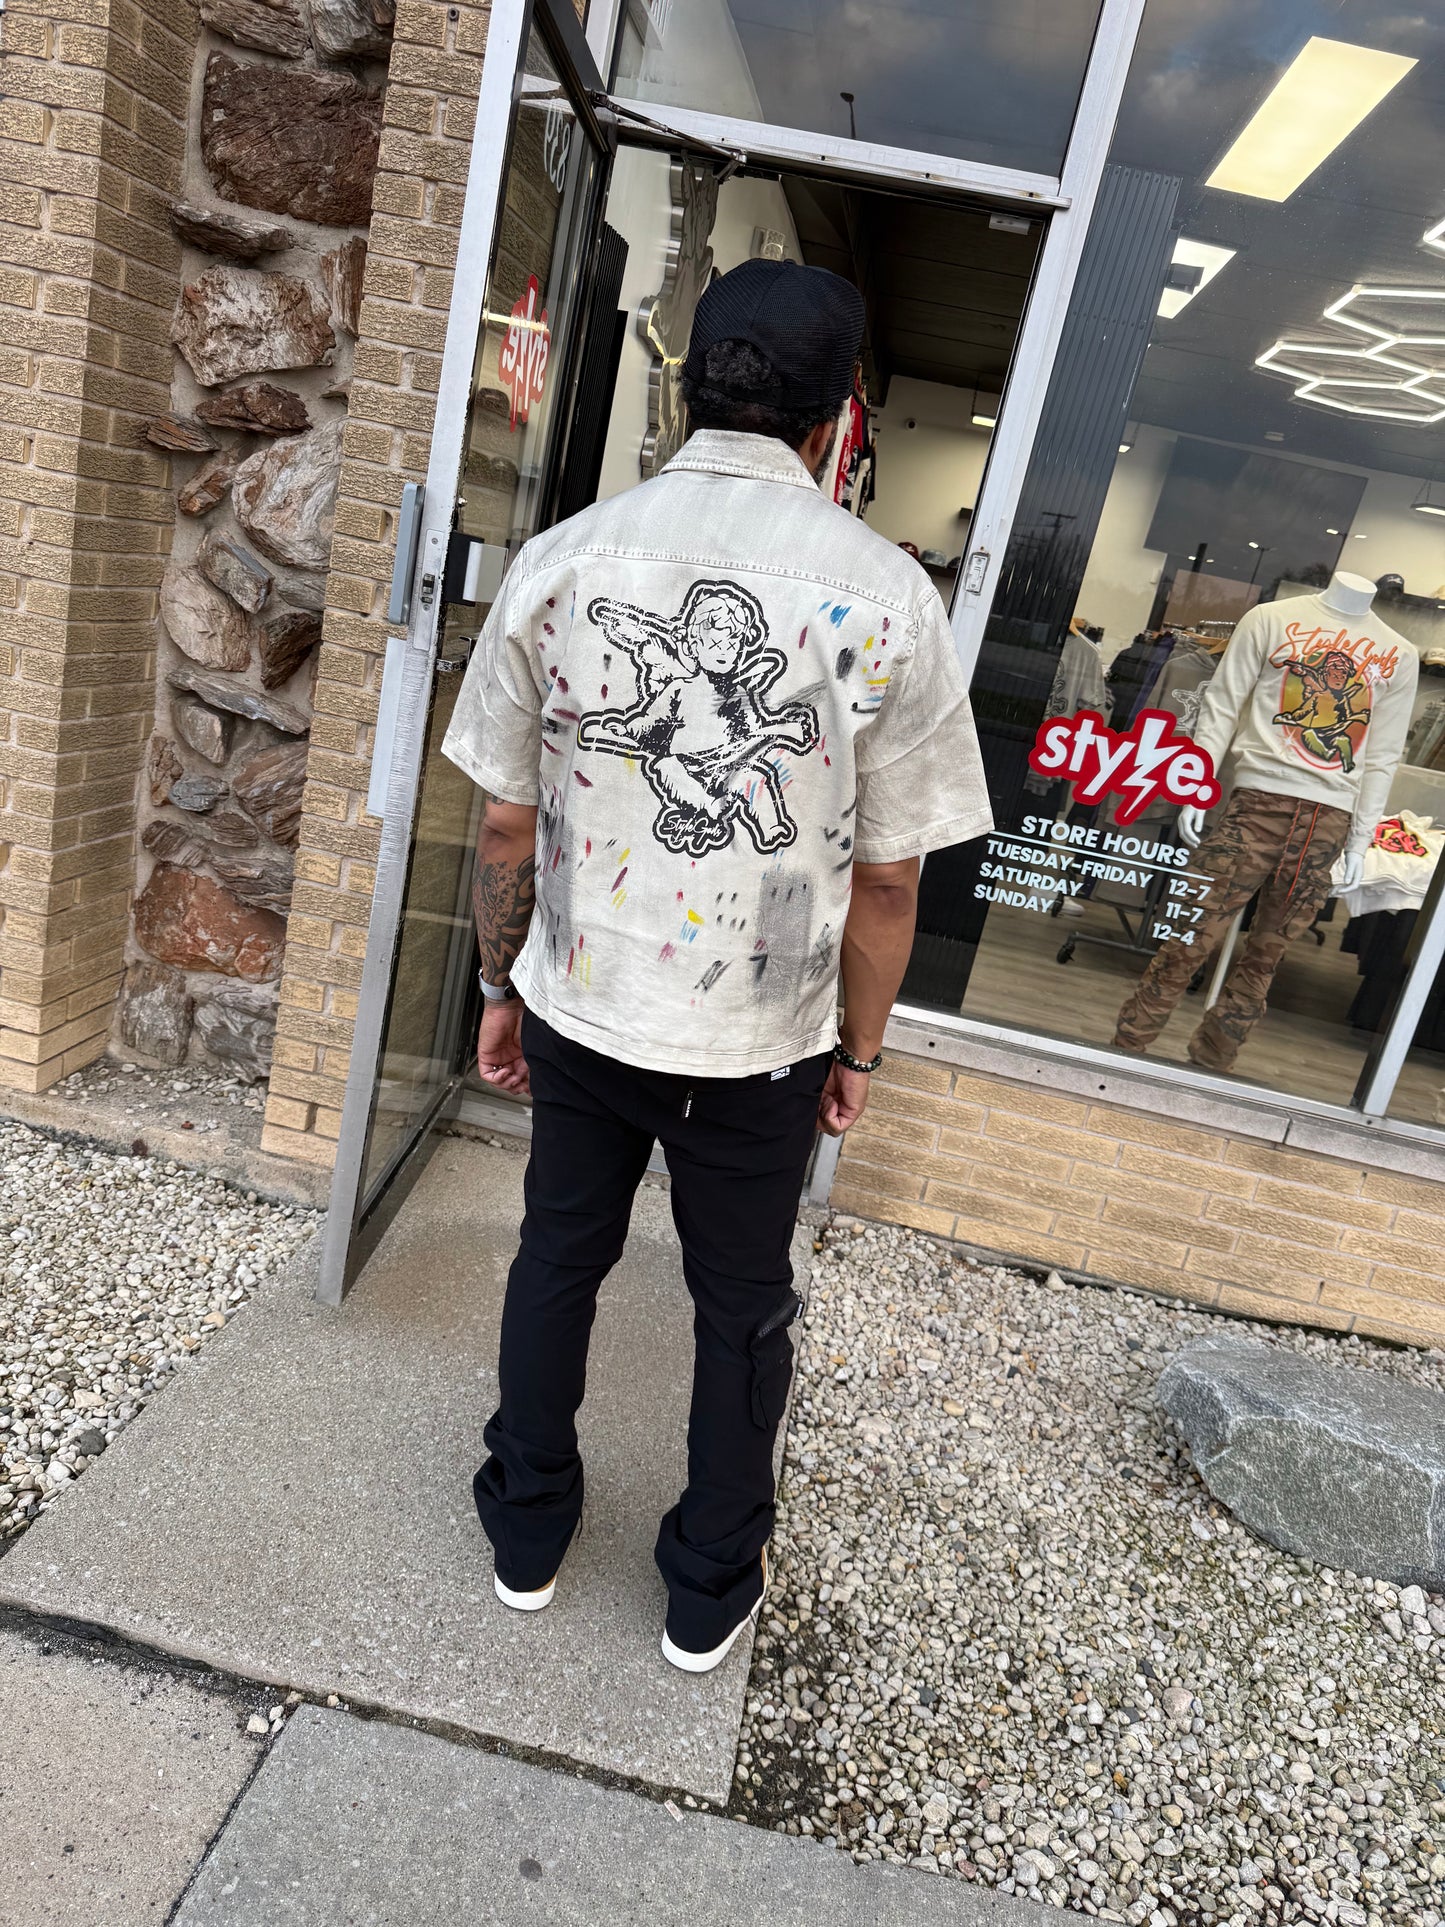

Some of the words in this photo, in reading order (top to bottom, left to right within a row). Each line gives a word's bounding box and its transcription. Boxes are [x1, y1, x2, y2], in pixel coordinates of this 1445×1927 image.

[986, 839, 1154, 889] TUESDAY-FRIDAY
[1168, 878, 1212, 901] 12-7
[1021, 815, 1101, 849] STORE
[1102, 832, 1190, 867] HOURS
[973, 883, 1055, 913] SUNDAY
[1151, 922, 1196, 946] 12-4
[979, 862, 1084, 897] SATURDAY
[1165, 902, 1204, 923] 11-7
